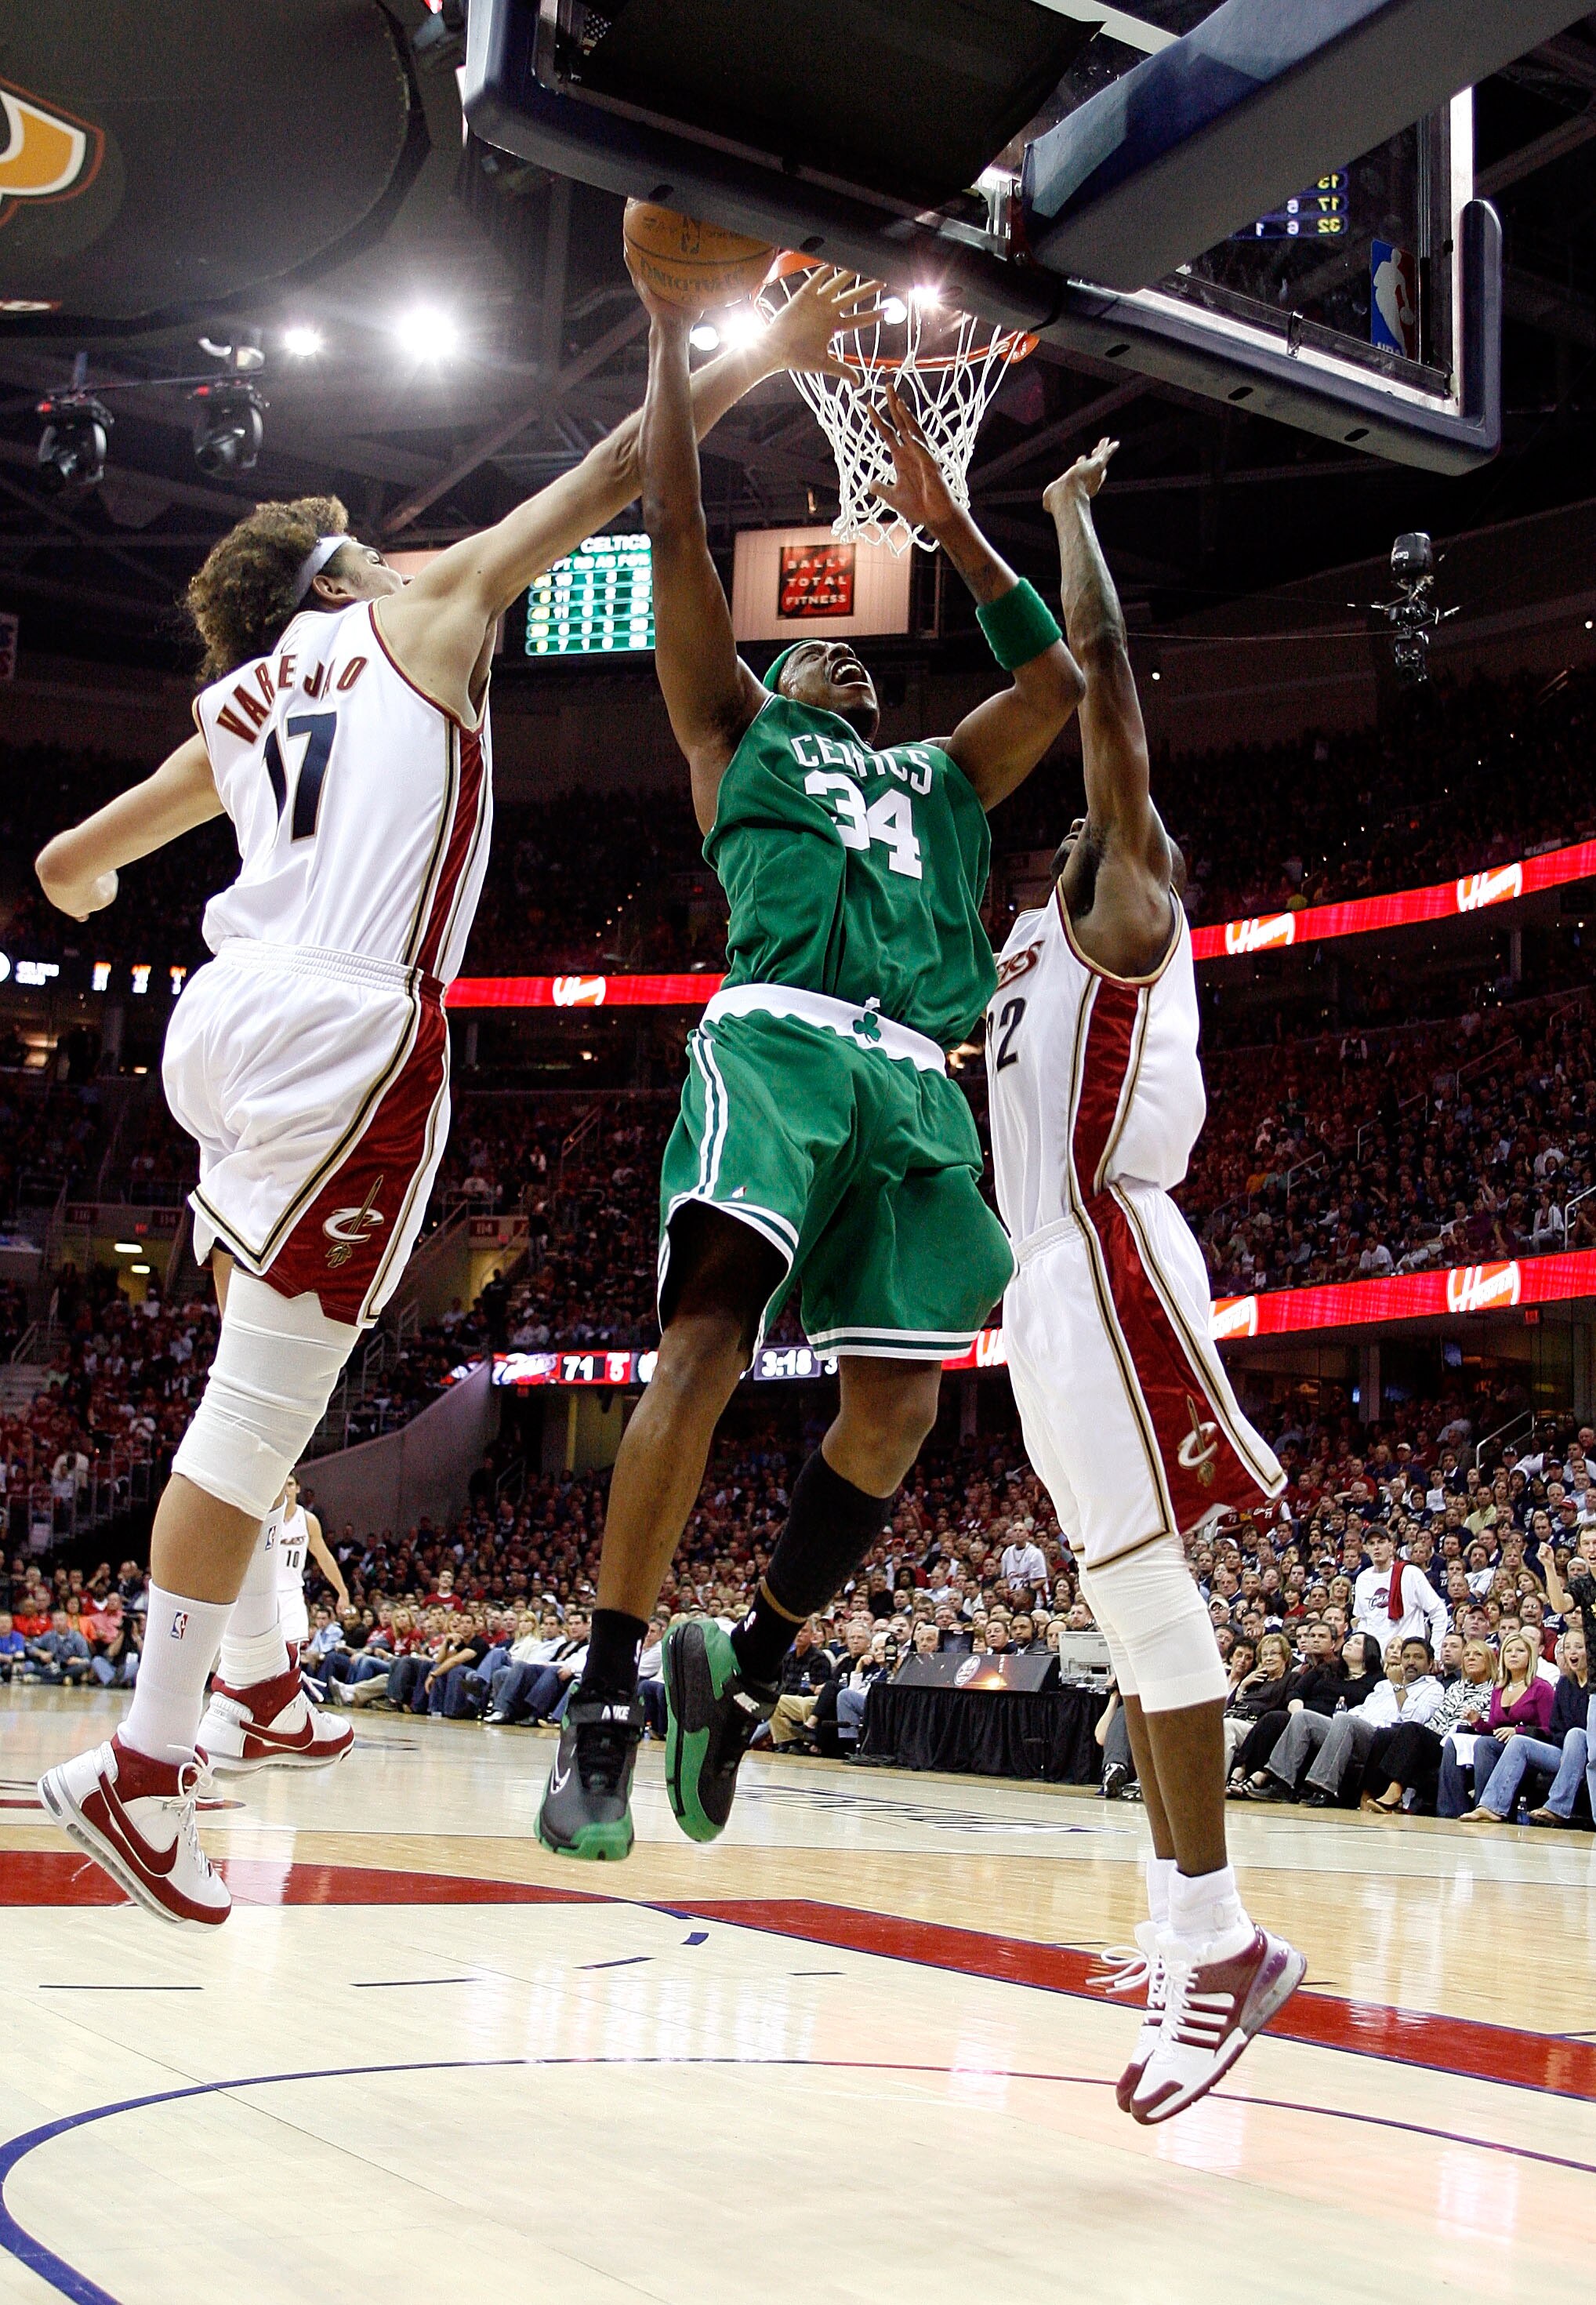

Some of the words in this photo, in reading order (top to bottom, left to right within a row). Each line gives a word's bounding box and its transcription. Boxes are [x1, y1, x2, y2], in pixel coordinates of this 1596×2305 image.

[581, 534, 651, 554] CELTICS
[787, 557, 847, 569] BALLY
[787, 575, 847, 587] TOTAL
[554, 590, 571, 603] 11
[785, 594, 847, 605] FITNESS
[553, 606, 569, 619] 11
[263, 710, 338, 844] 17
[803, 769, 923, 880] 34
[563, 1356, 594, 1381] 71
[286, 1550, 299, 1568] 10
